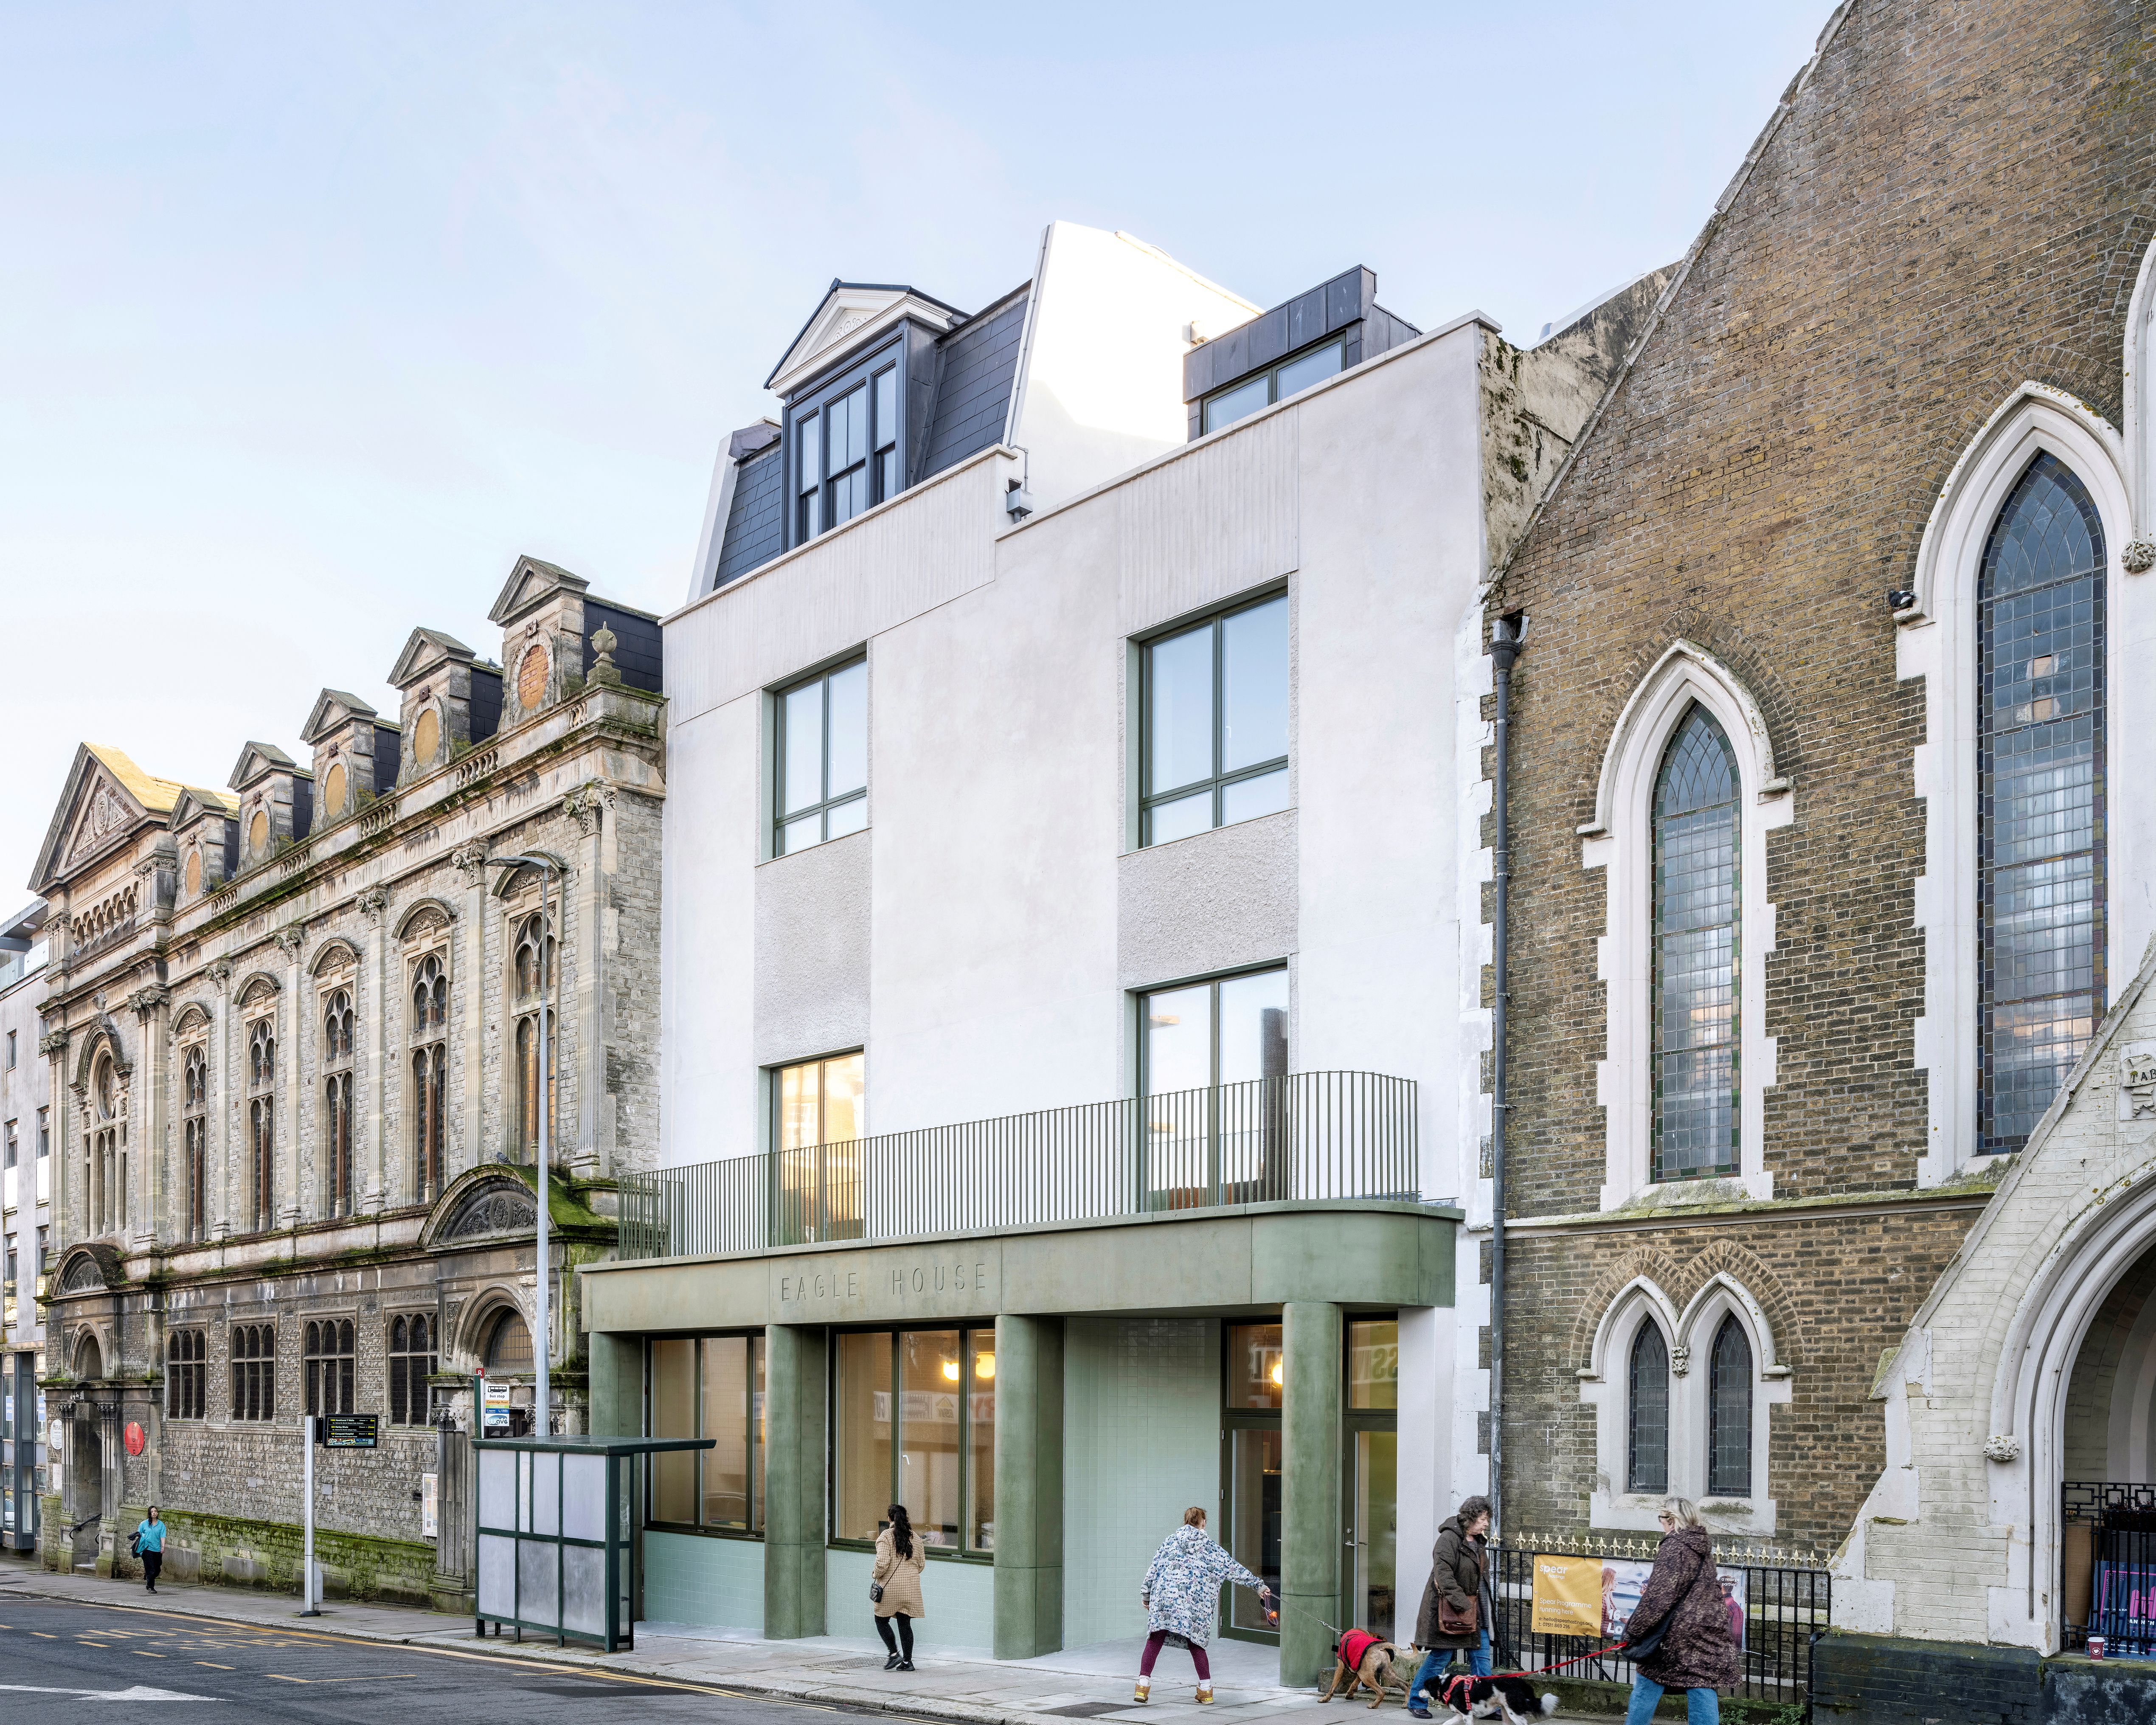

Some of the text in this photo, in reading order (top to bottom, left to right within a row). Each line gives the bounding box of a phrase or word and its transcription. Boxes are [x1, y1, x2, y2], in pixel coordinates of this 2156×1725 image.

[782, 1263, 985, 1302] EAGLE HOUSE
[1540, 1565, 1568, 1574] spear
[1557, 1599, 1592, 1608] Programme
[1539, 1607, 1561, 1615] running
[1608, 1609, 1621, 1620] 16
[1543, 1617, 1593, 1627] hello@spearhastings.org
